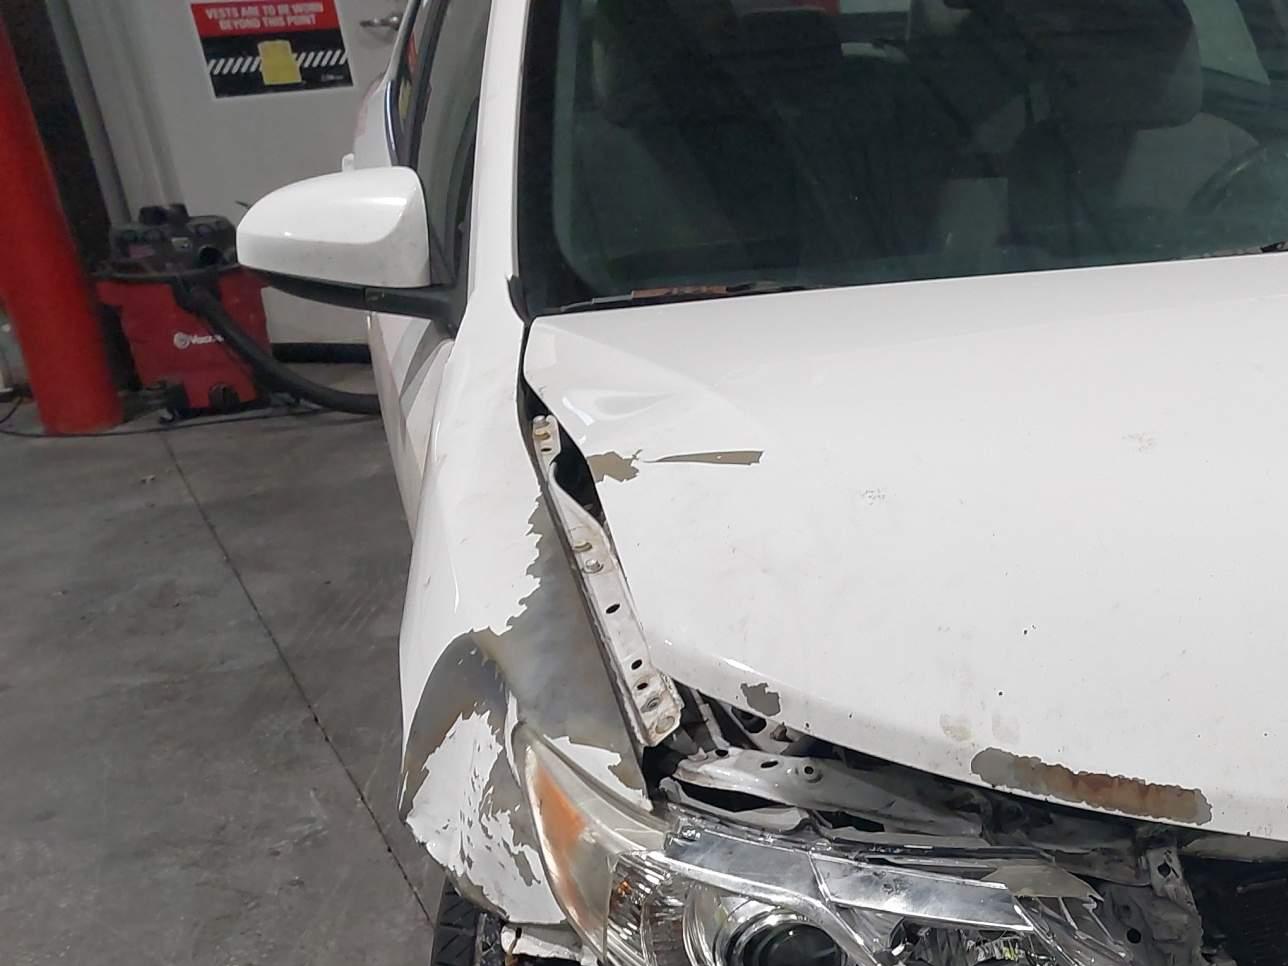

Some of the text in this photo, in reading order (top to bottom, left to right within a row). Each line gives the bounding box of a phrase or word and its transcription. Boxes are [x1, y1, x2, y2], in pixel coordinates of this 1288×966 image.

[205, 2, 324, 19] VESTS ARE TO BE WORN
[219, 14, 316, 31] BEYOND THIS POINT
